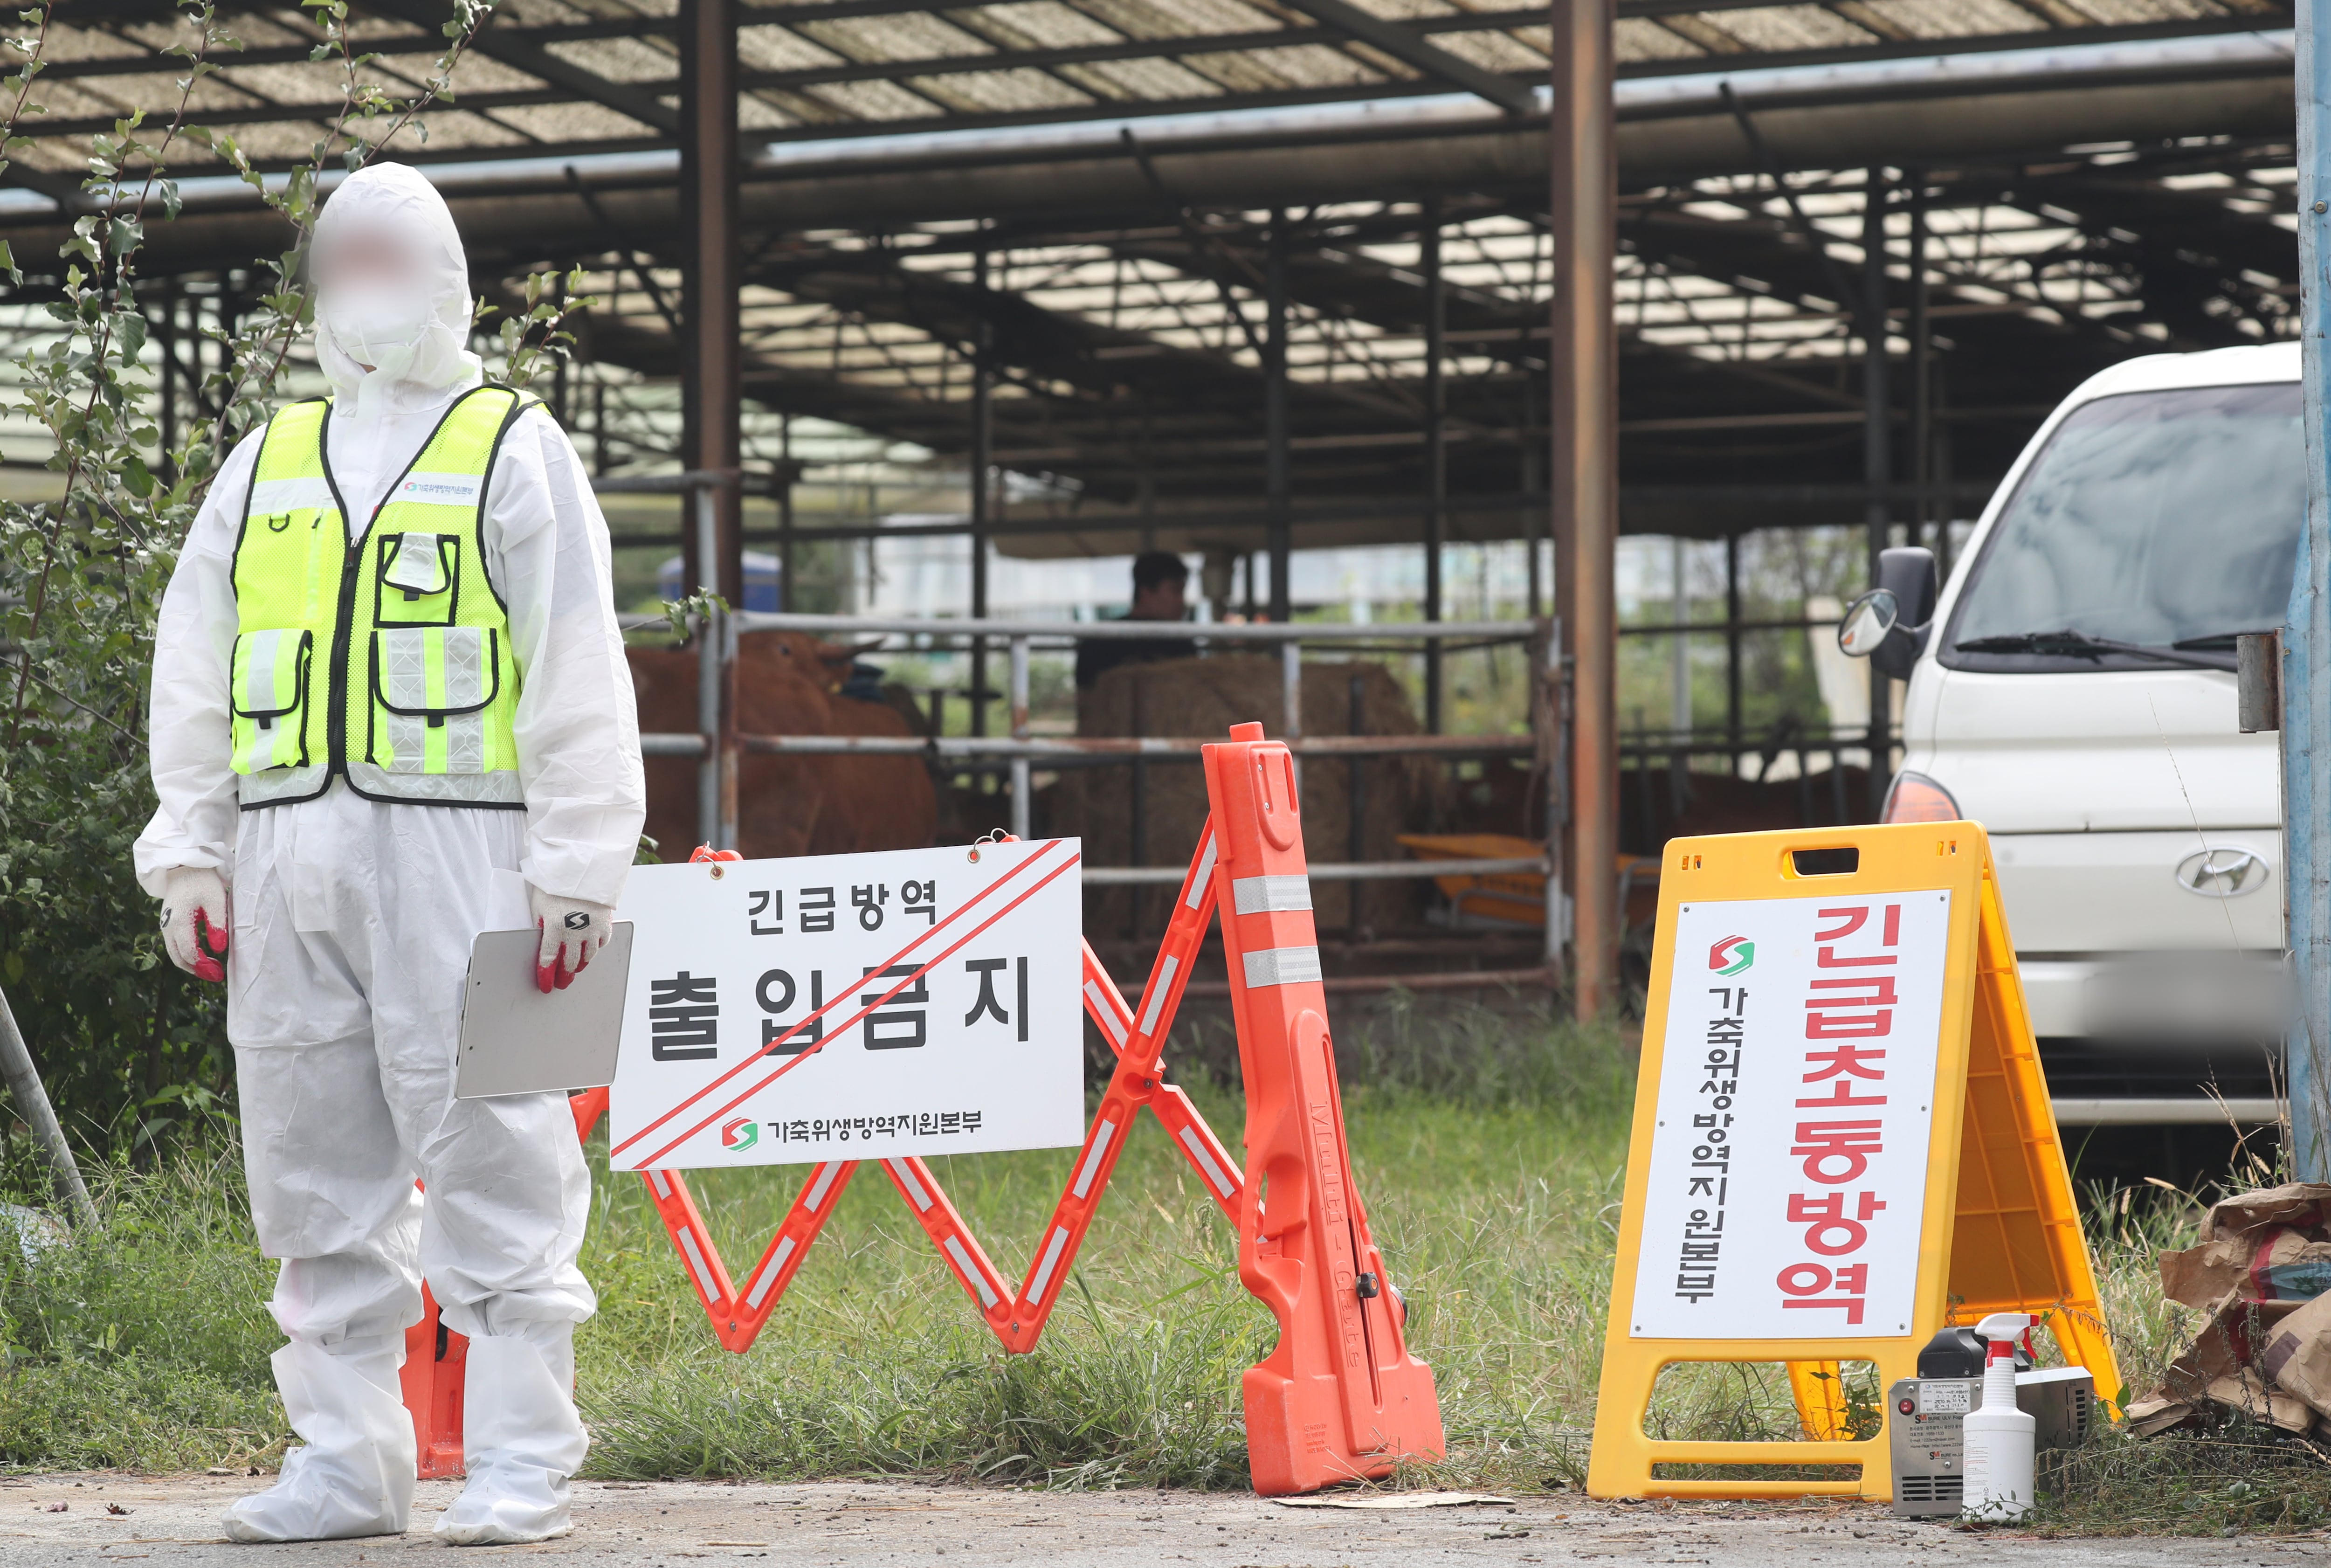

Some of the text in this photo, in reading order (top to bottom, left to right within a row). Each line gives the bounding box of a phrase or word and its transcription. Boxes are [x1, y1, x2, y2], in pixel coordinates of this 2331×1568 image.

[418, 484, 473, 495] 가축위생방역지원본부
[749, 880, 936, 936] 긴급방역
[648, 957, 1028, 1062] 출입금지
[767, 1111, 982, 1144] 가축위생방역지원본부
[1675, 988, 1748, 1303] 가축위생방역지원본부
[1776, 905, 1901, 1324] 긴급초동방역
